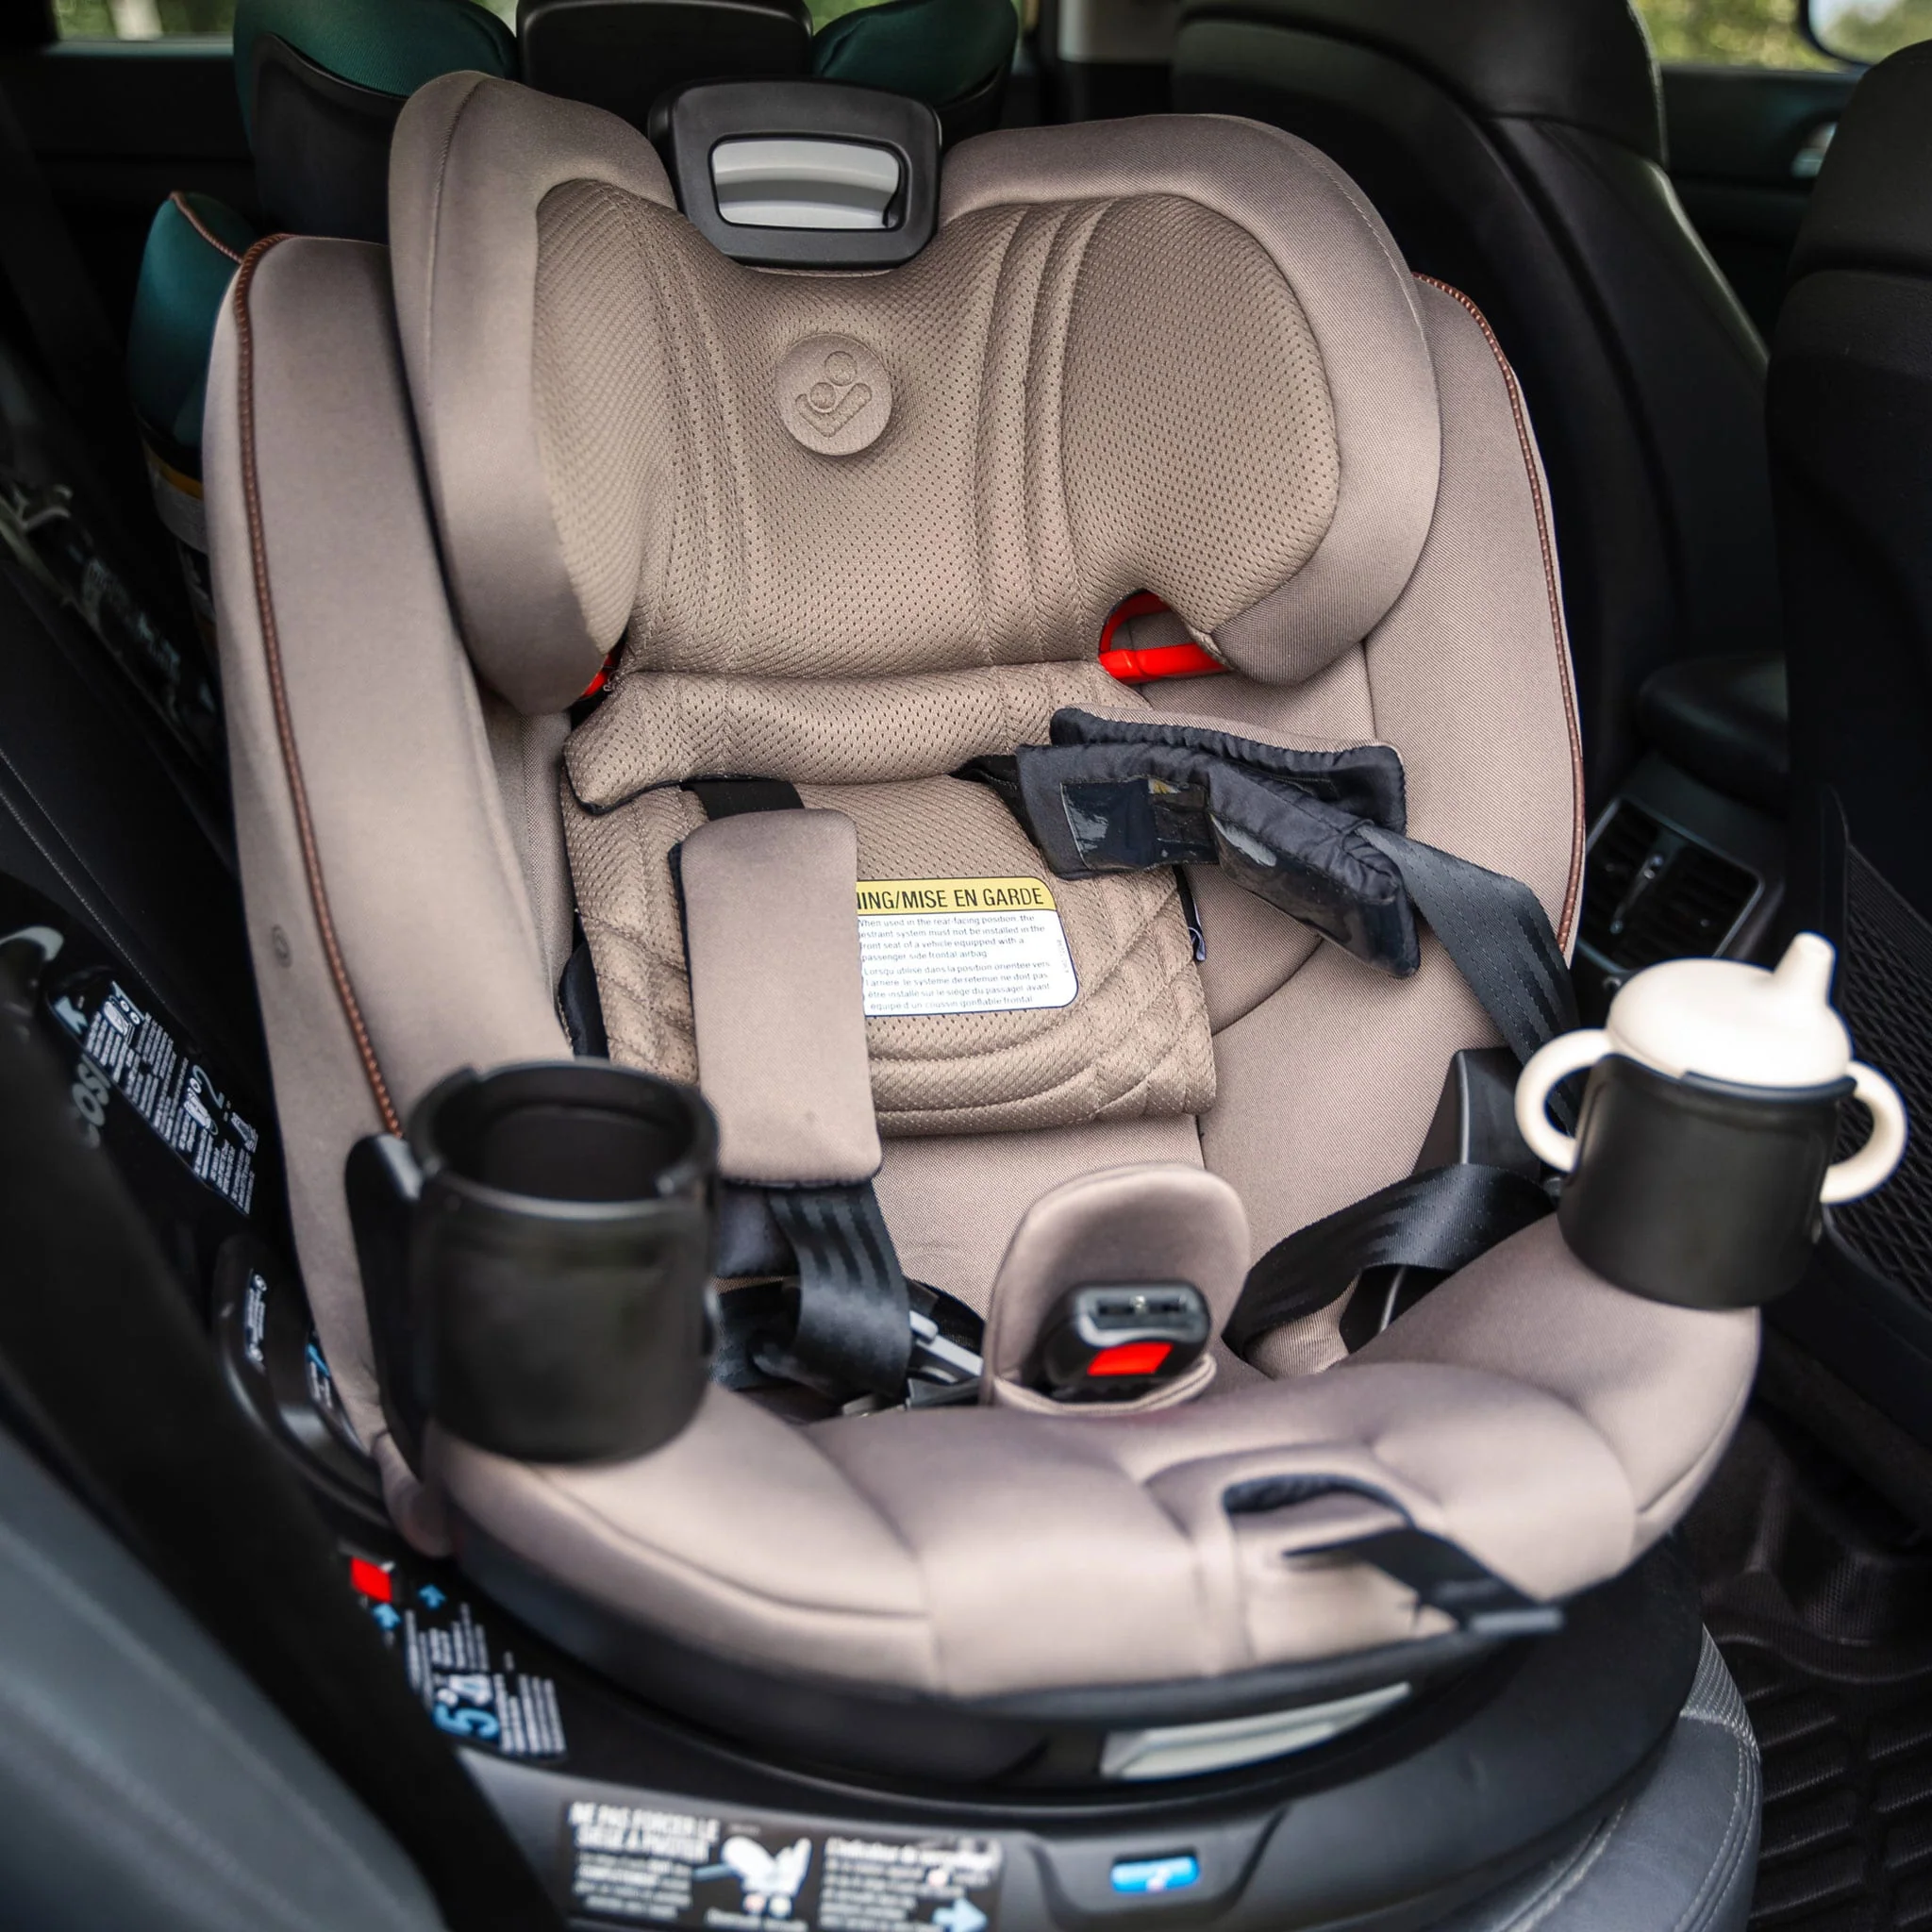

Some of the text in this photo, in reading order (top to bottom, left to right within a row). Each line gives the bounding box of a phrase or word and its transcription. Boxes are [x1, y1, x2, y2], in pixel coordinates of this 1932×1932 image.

[954, 889, 977, 907] EN
[983, 888, 1043, 906] GARDE
[884, 919, 905, 927] used
[917, 917, 931, 925] the
[859, 930, 893, 939] estraint
[896, 930, 926, 939] system
[983, 926, 1019, 935] installed
[884, 941, 901, 949] seat
[954, 938, 996, 947] equipped
[998, 937, 1017, 945] with
[861, 954, 907, 962] passenger
[928, 950, 957, 959] frontal
[957, 964, 992, 974] position
[964, 975, 998, 984] retenue
[986, 985, 1024, 994] passager
[1004, 995, 1033, 1004] frontal
